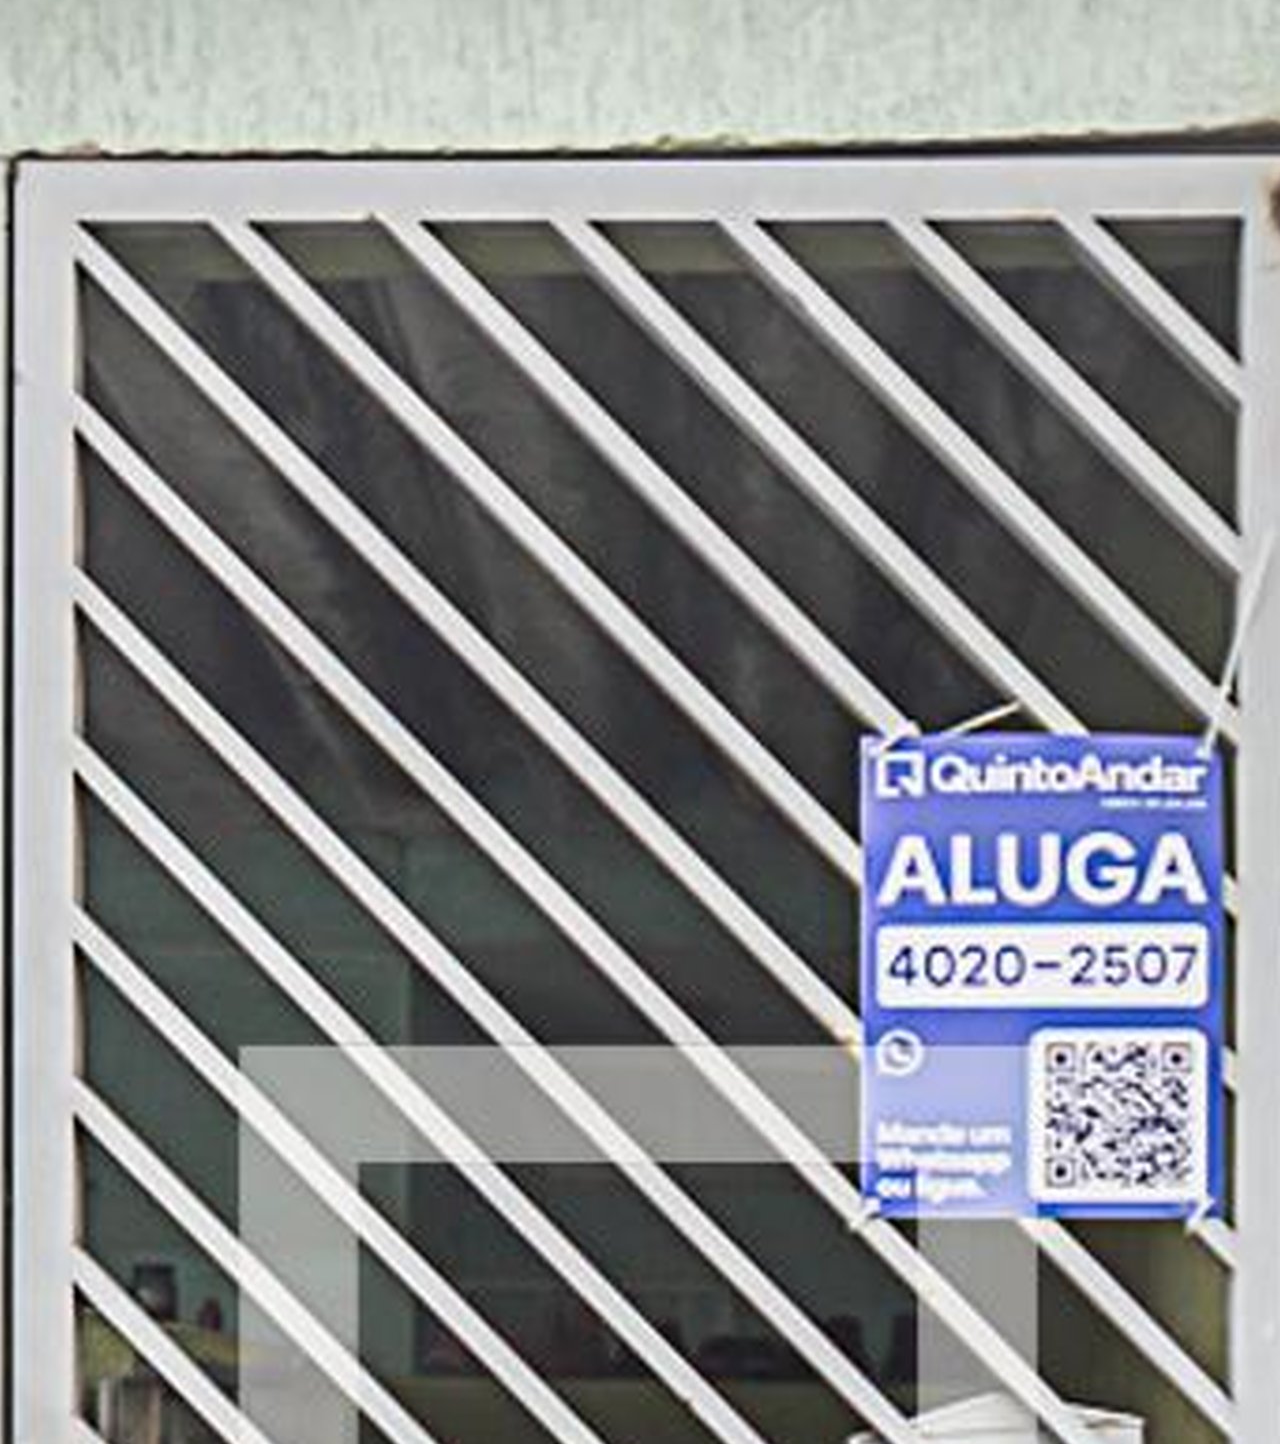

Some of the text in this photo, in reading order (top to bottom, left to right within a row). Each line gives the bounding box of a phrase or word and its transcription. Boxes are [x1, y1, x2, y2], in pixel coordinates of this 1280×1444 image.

[929, 753, 1208, 793] QuintoAndar
[876, 832, 1208, 906] ALUGA
[888, 943, 1199, 987] 4020-2507
